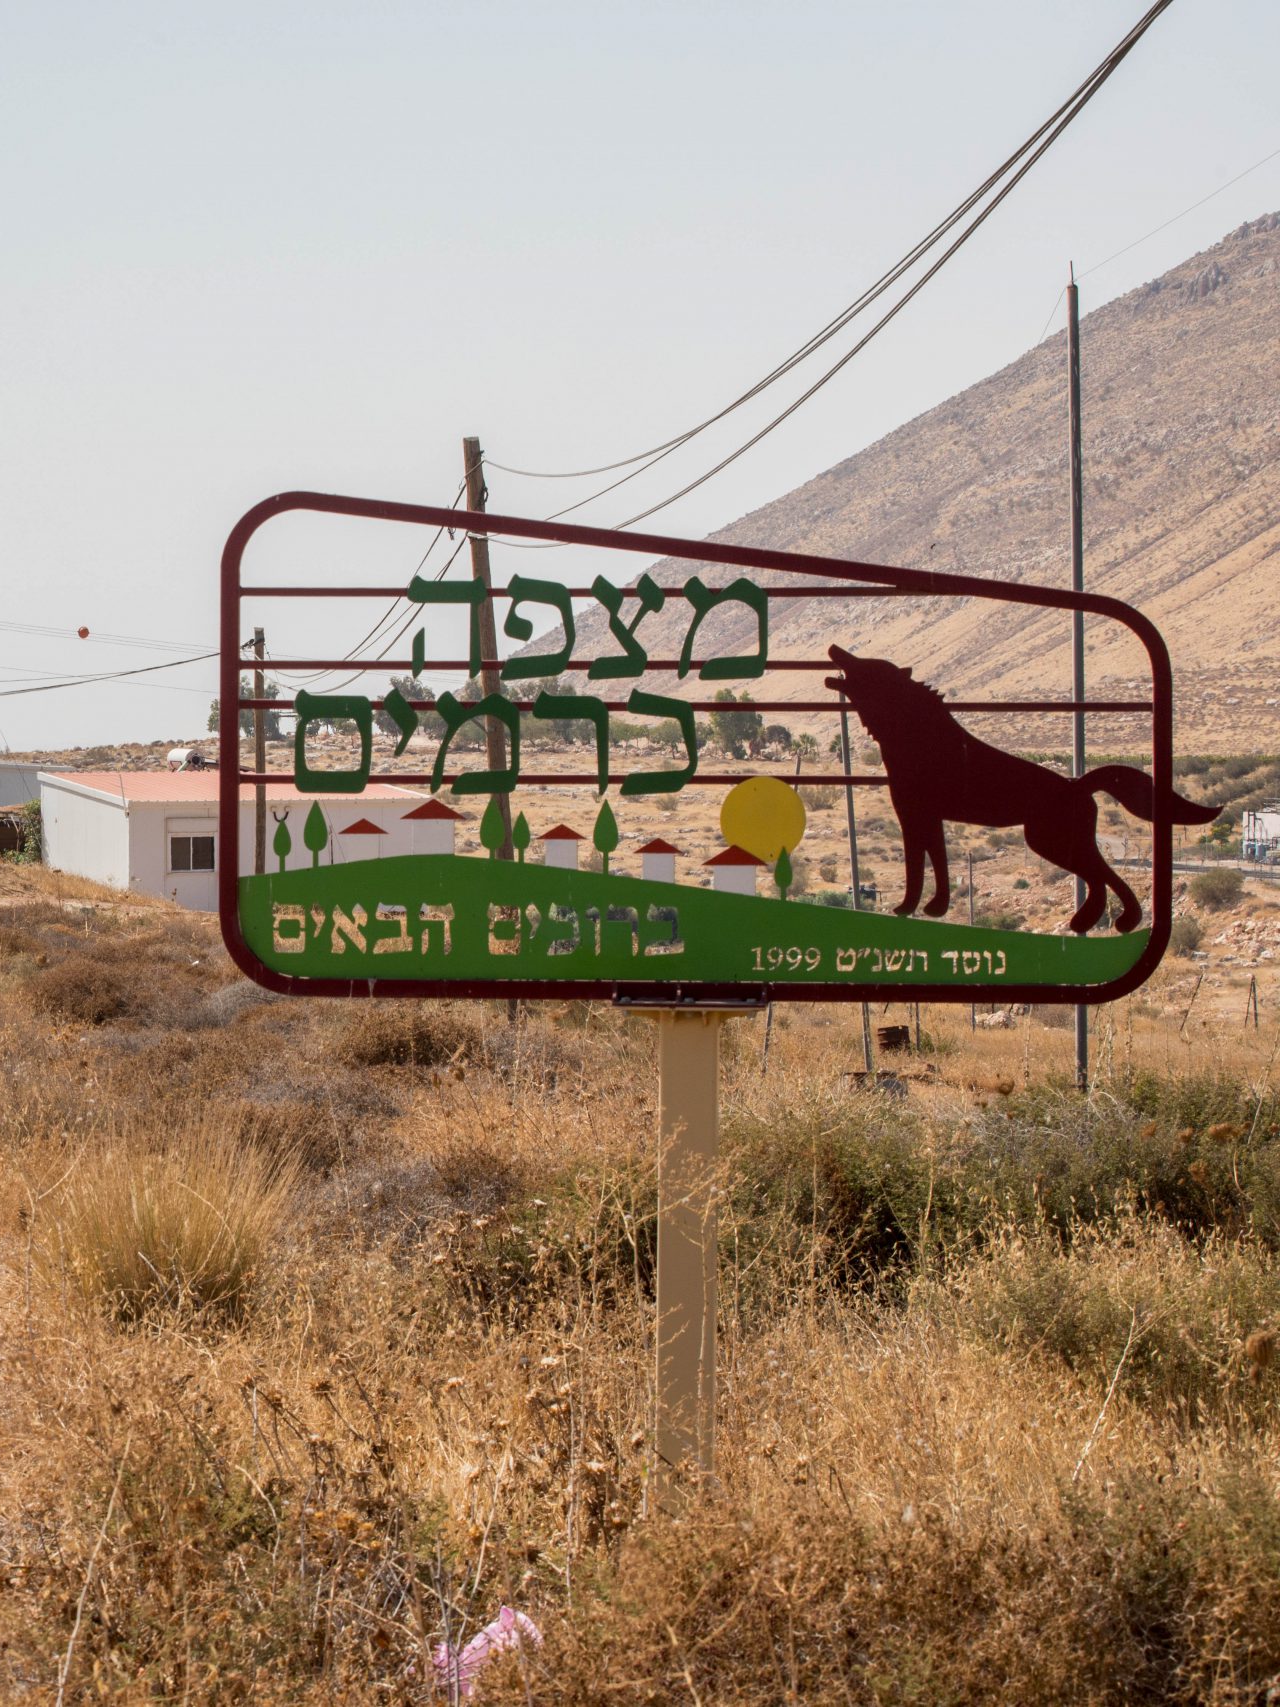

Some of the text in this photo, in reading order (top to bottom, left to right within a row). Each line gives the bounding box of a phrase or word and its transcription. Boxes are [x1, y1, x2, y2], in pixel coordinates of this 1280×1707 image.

[407, 573, 769, 680] מצפה
[294, 688, 698, 796] כרמים
[272, 902, 685, 957] ברוכים הבאים
[751, 946, 821, 971] 1999
[940, 949, 1006, 975] נוסד
